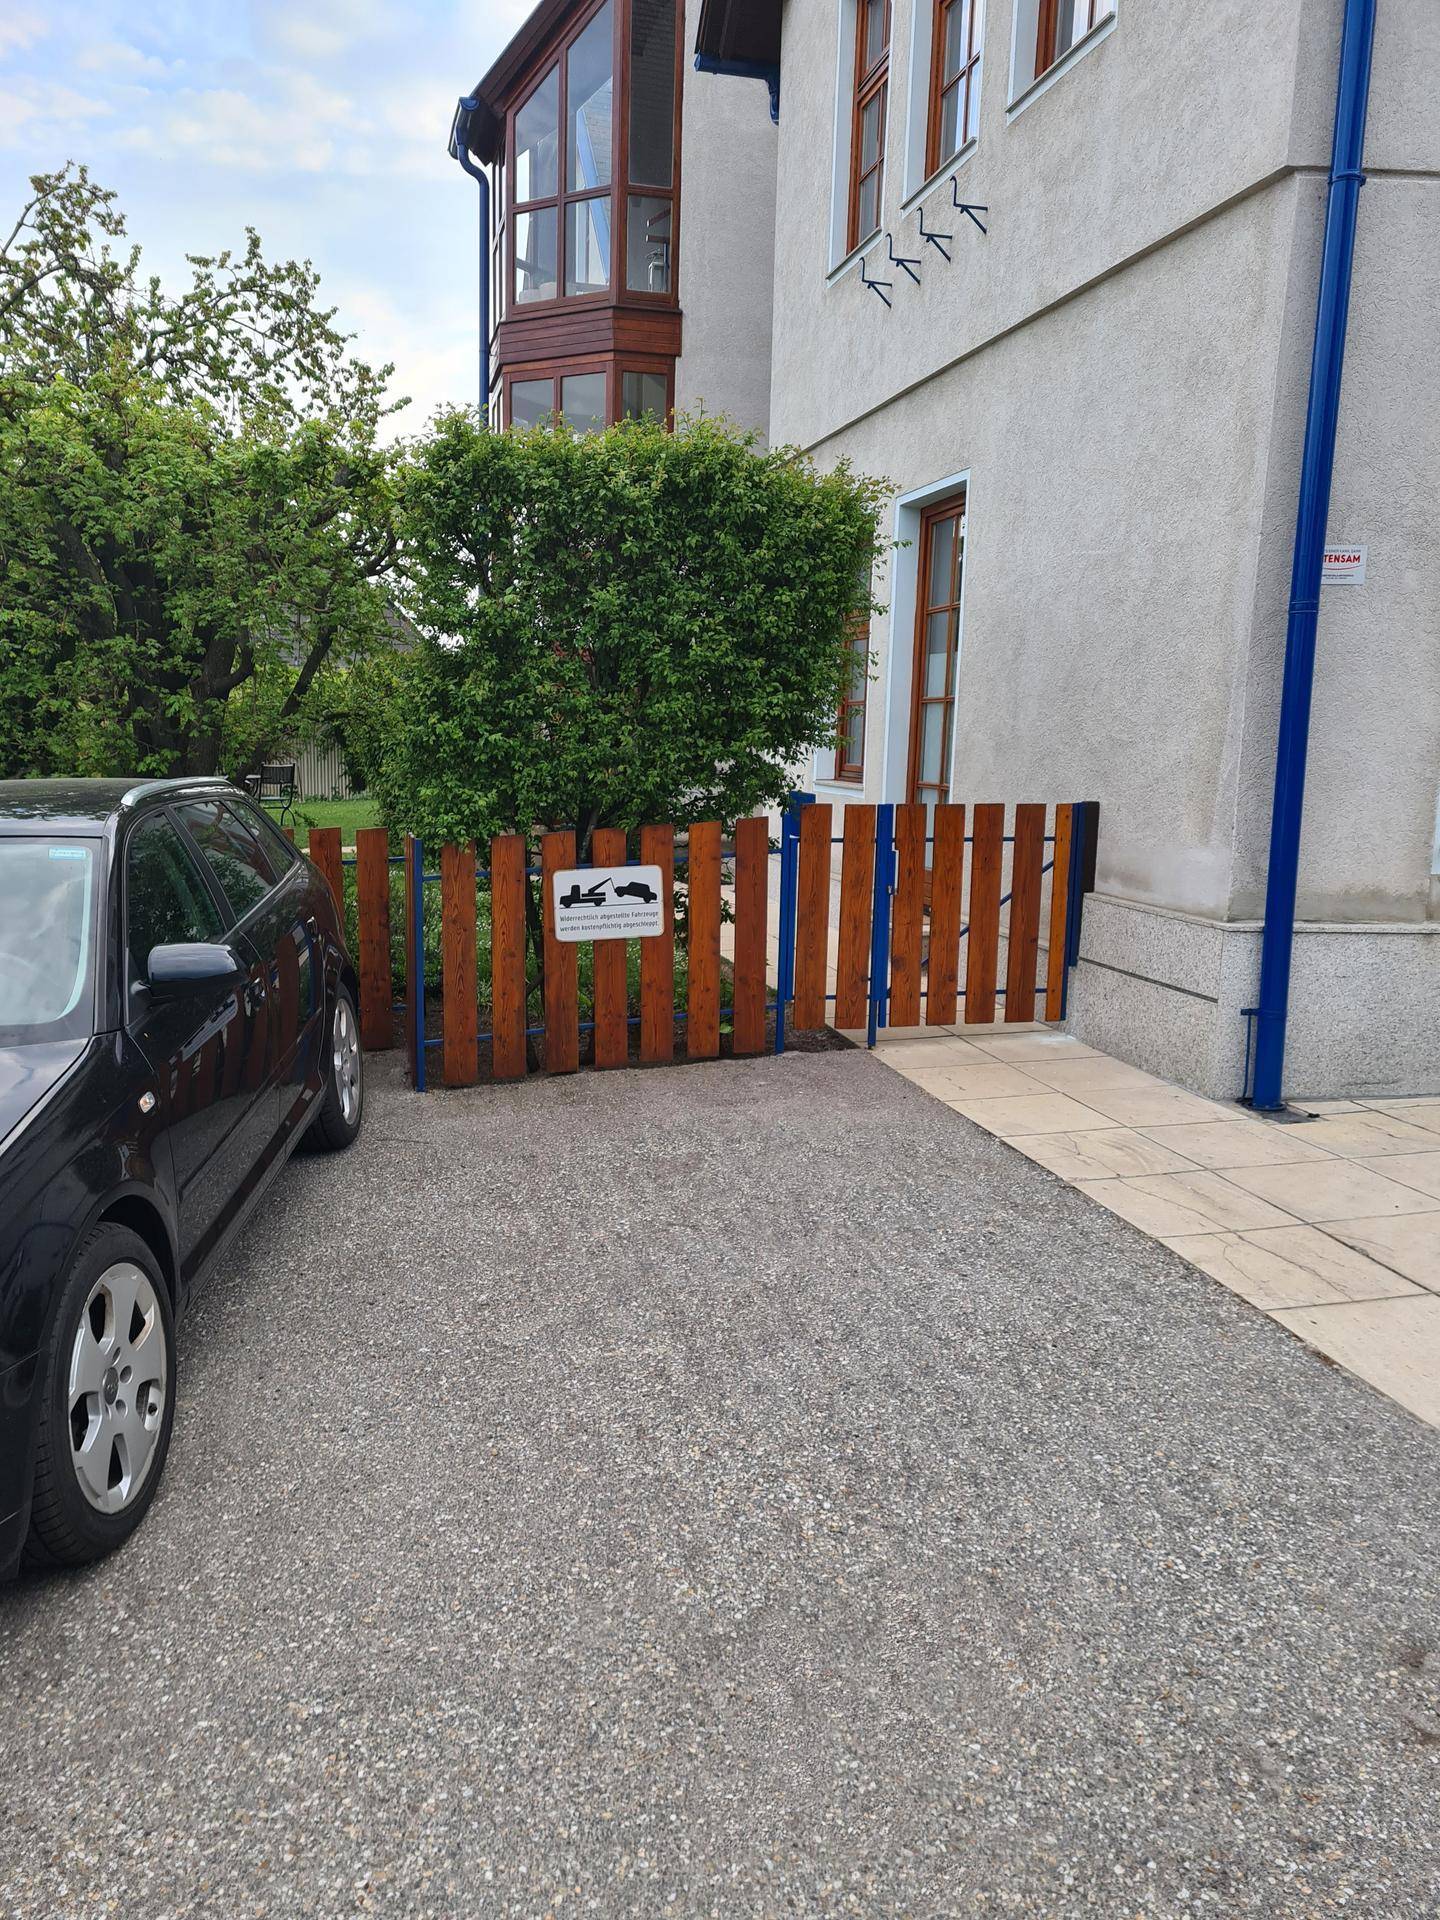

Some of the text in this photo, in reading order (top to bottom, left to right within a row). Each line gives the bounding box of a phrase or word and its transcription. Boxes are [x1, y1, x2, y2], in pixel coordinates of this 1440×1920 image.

[1323, 554, 1361, 563] TENSAM
[560, 912, 599, 922] Widerrechtlich
[600, 912, 630, 920] abgestellte
[581, 923, 622, 931] kostenpflichtig
